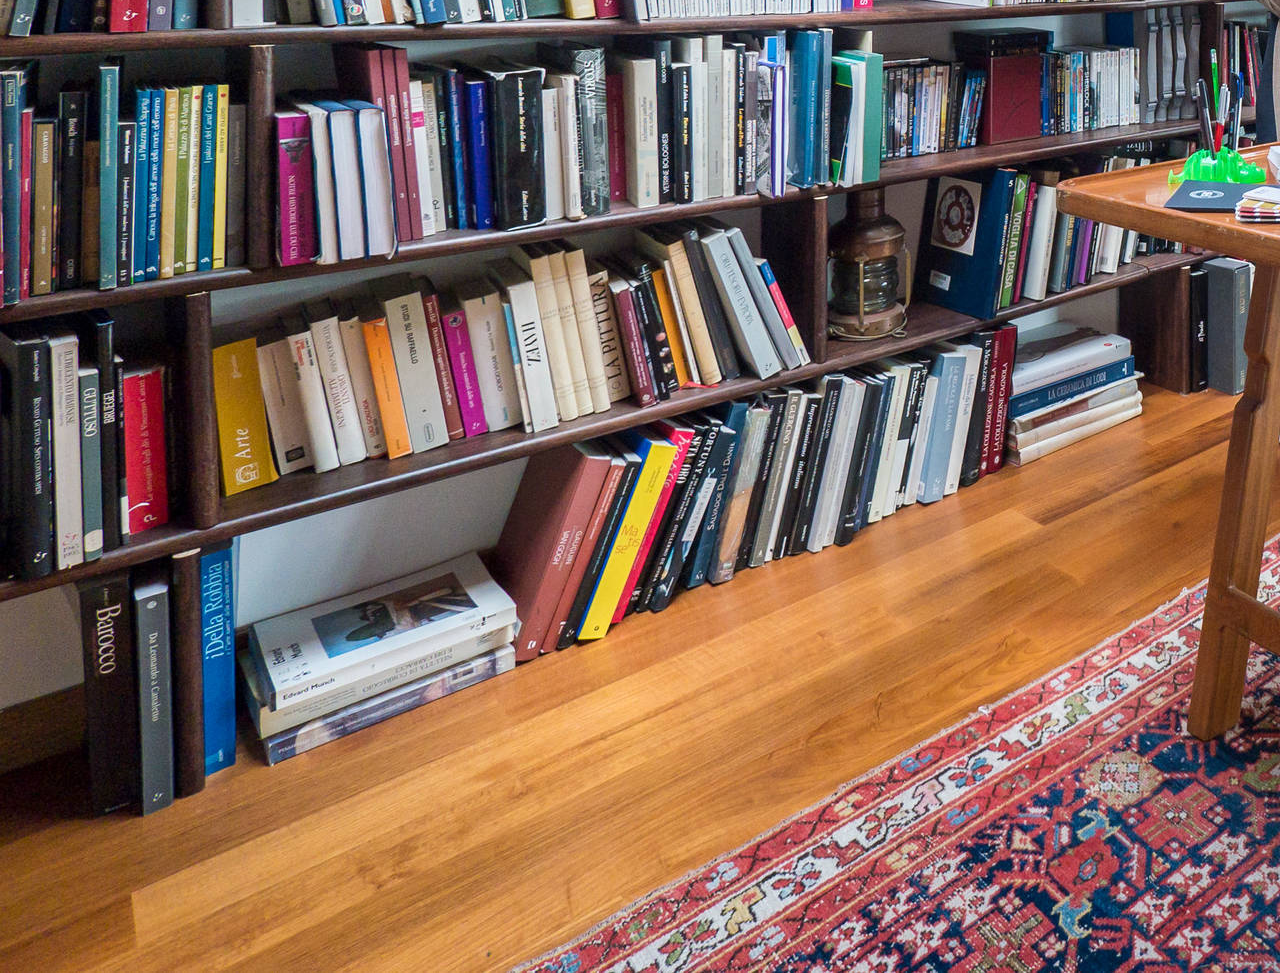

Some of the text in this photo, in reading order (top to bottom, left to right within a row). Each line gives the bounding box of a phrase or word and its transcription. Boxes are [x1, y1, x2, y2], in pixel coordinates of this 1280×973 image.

[582, 60, 596, 98] STORIA
[180, 92, 191, 118] Mantova
[67, 117, 78, 137] Bosch
[138, 127, 148, 153] Palazzina
[177, 132, 188, 155] Palazzo
[203, 91, 214, 160] palazzi del Canal Grande
[137, 153, 146, 161] La
[151, 148, 160, 162] della
[166, 143, 174, 151] La
[660, 133, 670, 193] VETRINE BOLOGNESI
[148, 192, 158, 212] trilogia
[520, 190, 529, 220] Editori Laterza
[1002, 209, 1023, 290] VOGLIA DI CASA
[400, 303, 418, 364] STUDI SU RAFFAELLO
[520, 320, 543, 366] HAYEZ
[586, 276, 623, 380] LA PITTURA
[64, 354, 73, 394] TRECENTO
[978, 338, 992, 393] IL MORAZZONE
[64, 393, 73, 426] RIMINESE
[83, 387, 97, 437] GUTTUSO
[104, 389, 114, 423] BRUEGEL
[789, 394, 799, 404] IL
[981, 366, 998, 457] LA COLLEZIONE CAGNOLA
[992, 361, 1009, 451] LA COLLEZIONE CAGNOLA
[780, 403, 797, 444] GUERCINO
[235, 427, 252, 459] Arte
[685, 433, 703, 459] SETA
[692, 424, 719, 474] FORTUNY
[791, 402, 817, 489] Impressionismo italiano
[675, 462, 692, 486] ORO
[706, 490, 723, 531] SALVADOR
[551, 529, 570, 565] VAN GOGH
[564, 529, 582, 565] GAUGUIN
[204, 562, 224, 613] Robbia
[96, 603, 121, 674] Barocco
[149, 632, 159, 643] Da
[149, 644, 159, 679] Leonardo
[149, 685, 159, 722] Canaletto
[282, 677, 335, 700] Edvard Munch
